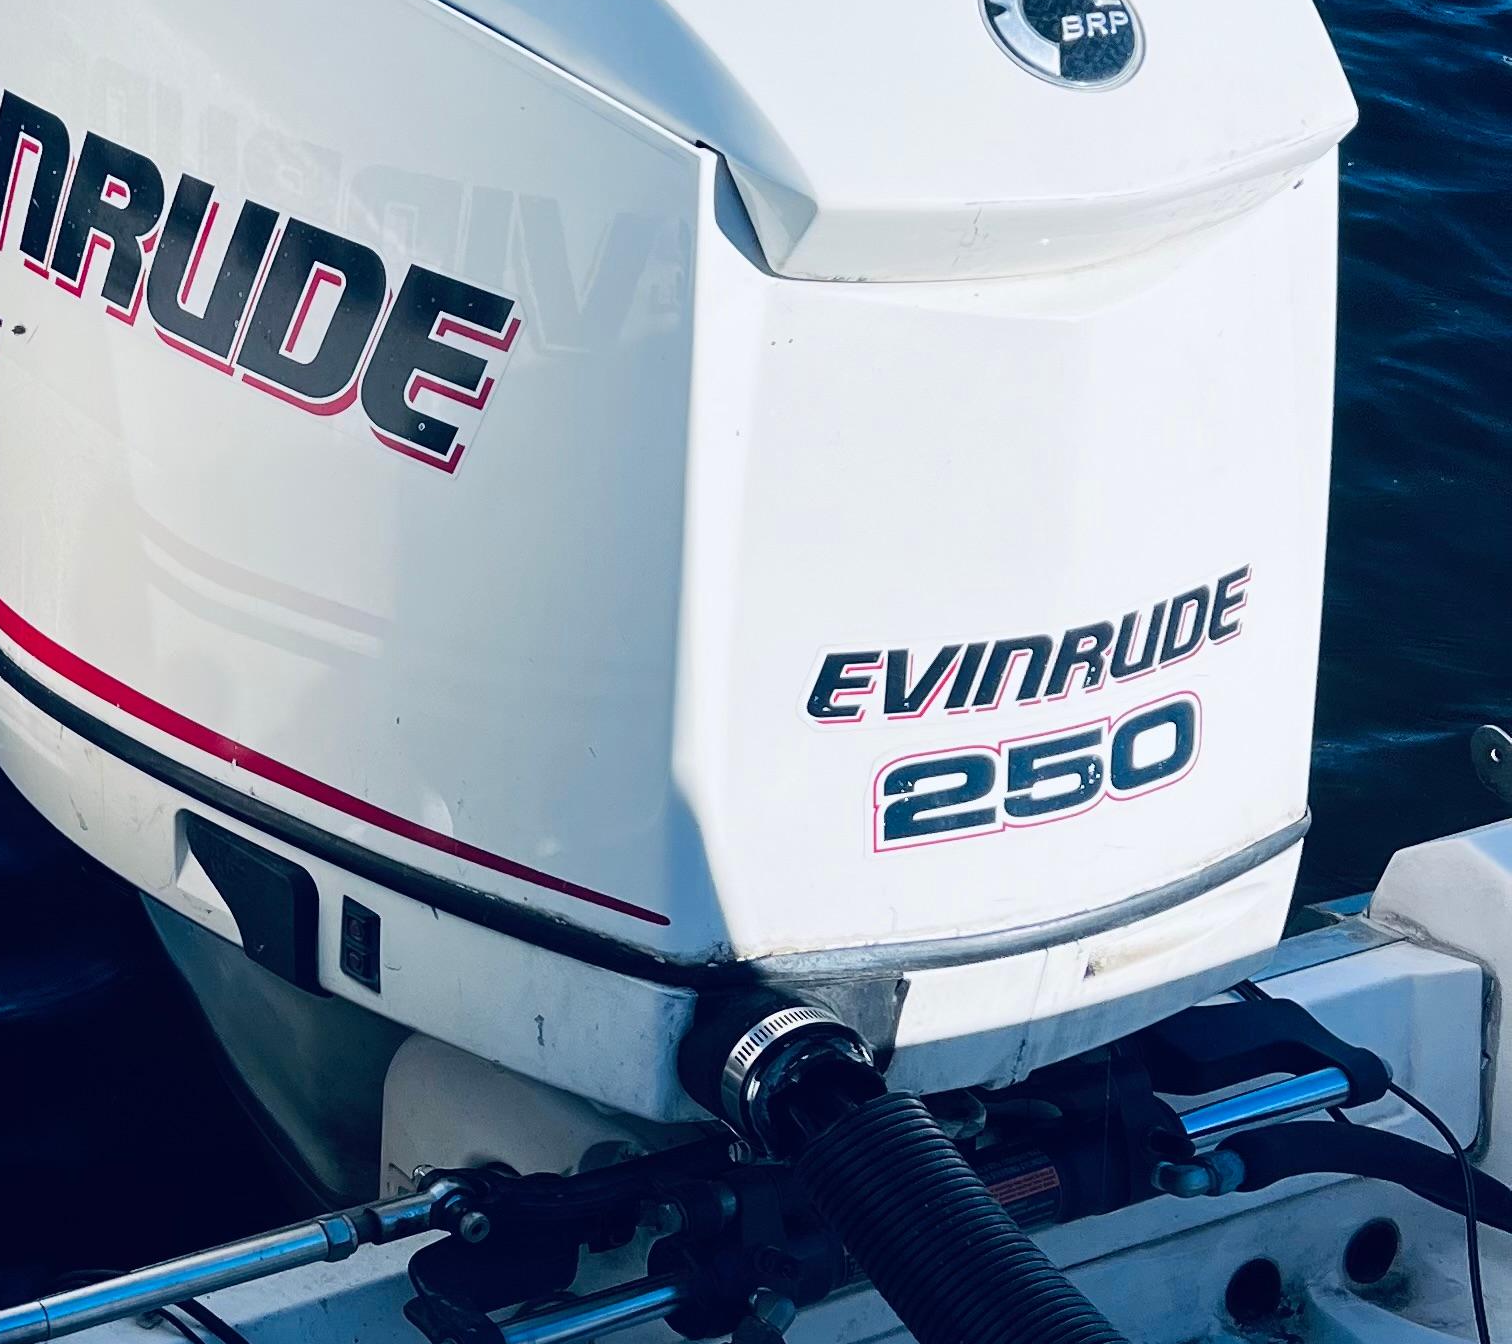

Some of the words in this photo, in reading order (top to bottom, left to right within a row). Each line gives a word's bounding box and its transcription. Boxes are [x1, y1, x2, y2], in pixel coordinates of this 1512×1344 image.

[1061, 10, 1129, 42] BRP
[806, 563, 1251, 724] EVINRUDE
[882, 698, 1196, 842] 250
